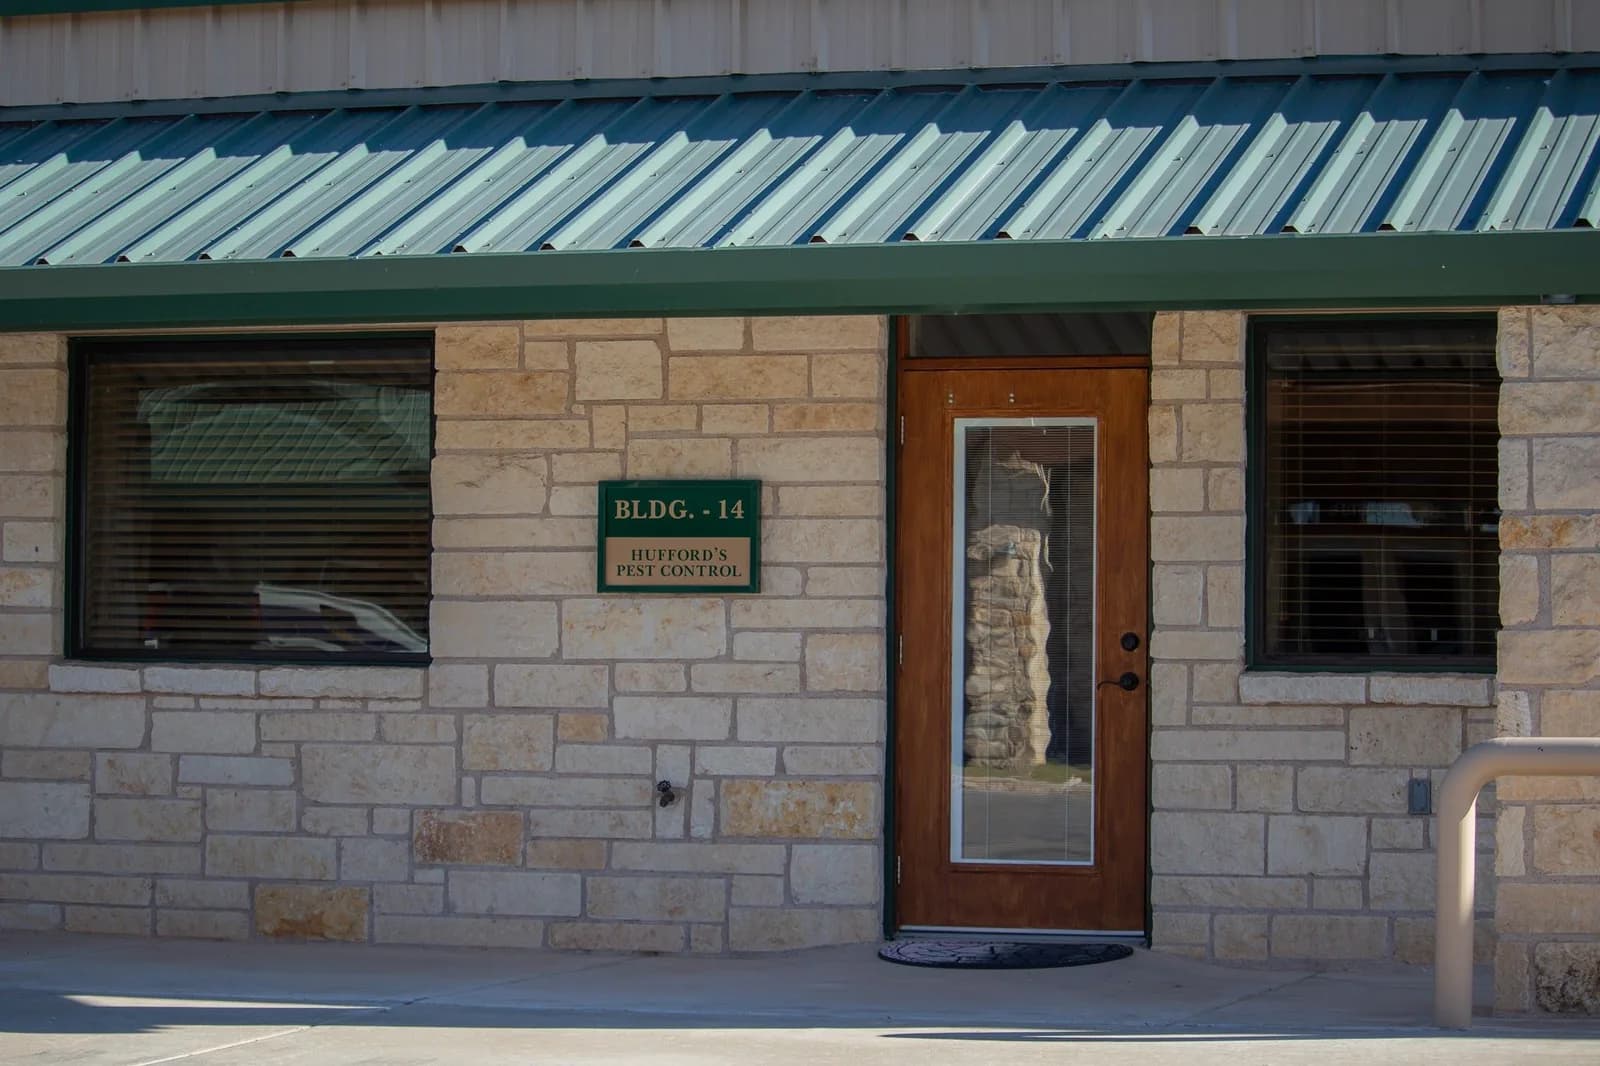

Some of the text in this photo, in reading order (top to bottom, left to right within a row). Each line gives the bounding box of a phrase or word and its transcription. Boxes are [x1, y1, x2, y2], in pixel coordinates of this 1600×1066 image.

[614, 499, 694, 519] BLDG.
[719, 499, 745, 519] 14
[631, 547, 727, 561] HUFFORD'S
[616, 564, 742, 577] PEST CONTROL
